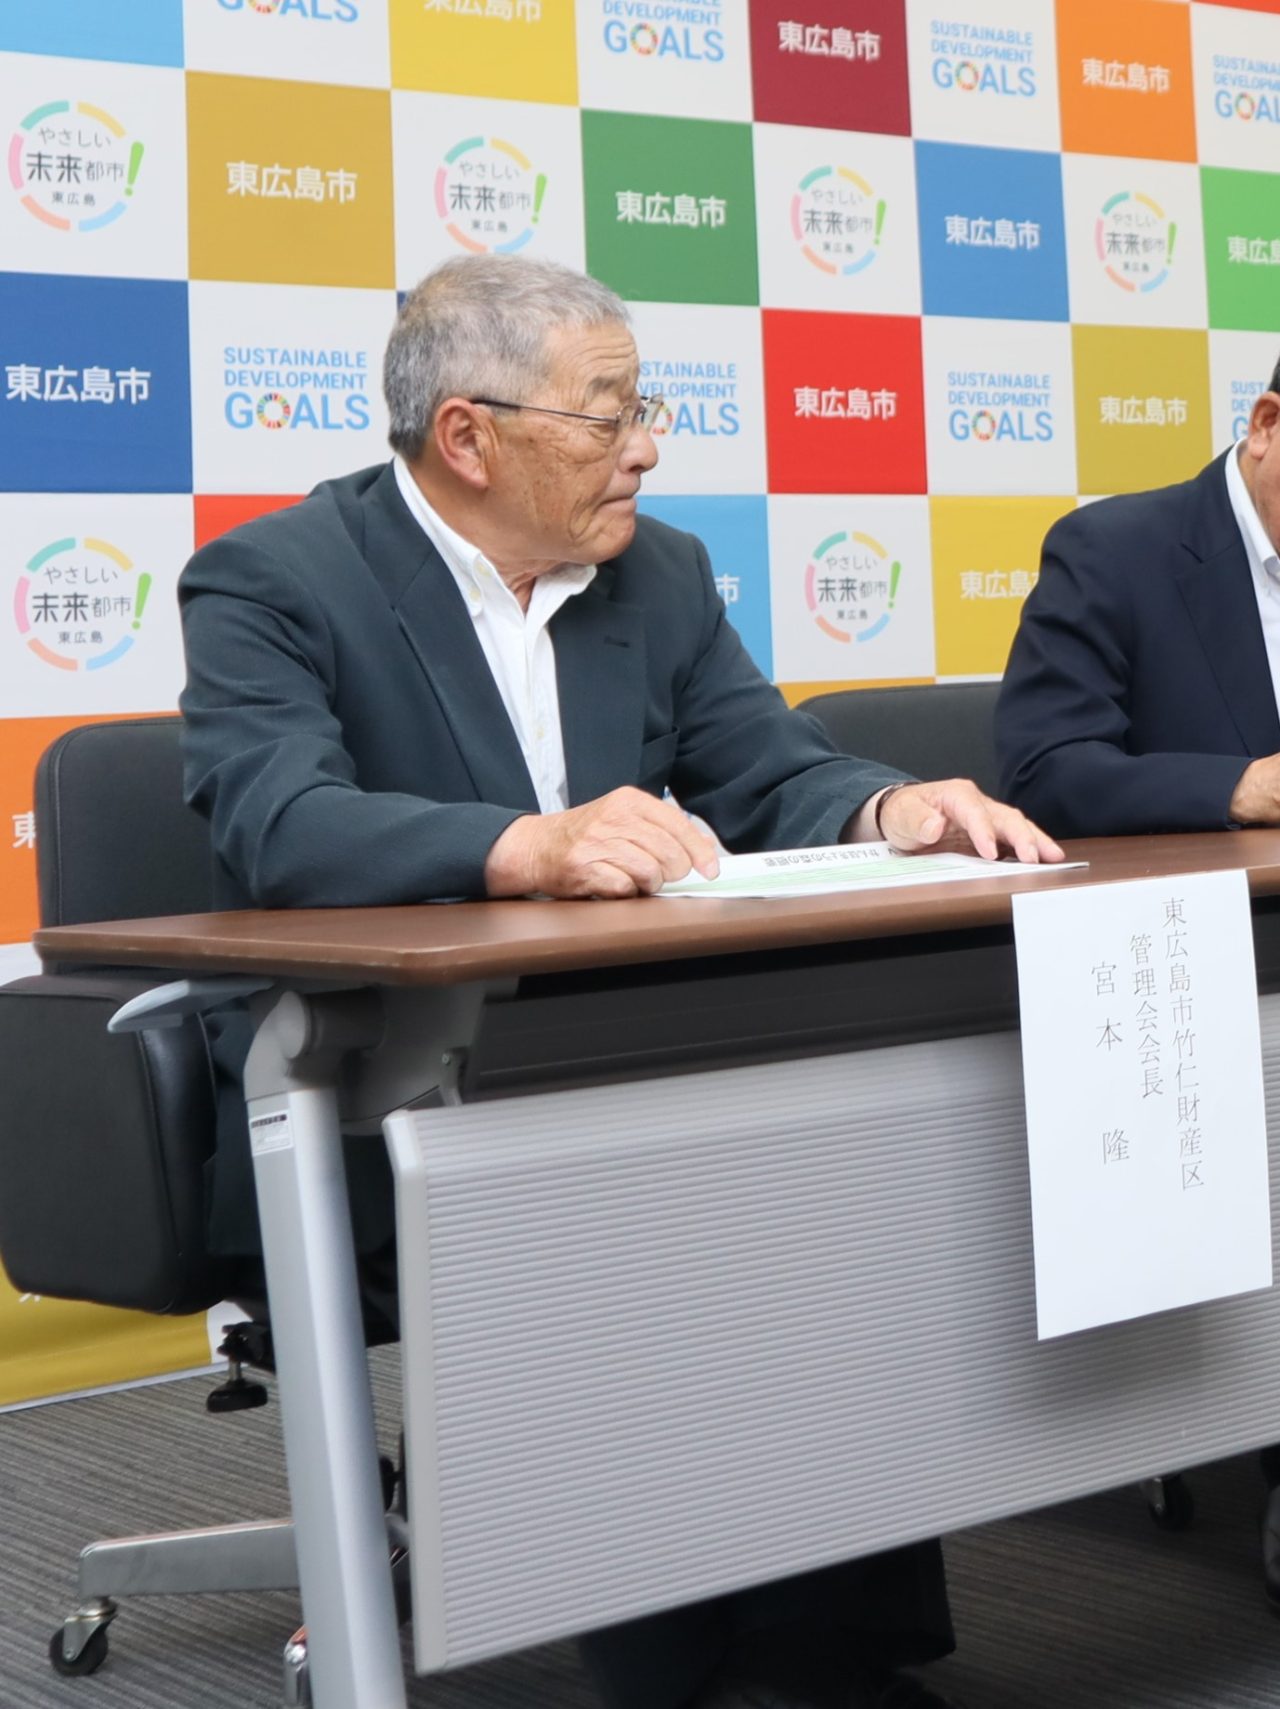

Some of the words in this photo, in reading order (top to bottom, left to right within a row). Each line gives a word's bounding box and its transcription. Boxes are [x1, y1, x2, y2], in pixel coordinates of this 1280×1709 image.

[603, 0, 720, 25] DEVELOPMENT
[604, 20, 724, 62] GOALS
[778, 21, 880, 61] 東広島市
[931, 20, 1033, 46] SUSTAINABLE
[931, 38, 1033, 62] DEVELOPMENT
[932, 58, 1036, 96] GOALS
[1082, 58, 1169, 92] 東広島市
[38, 127, 111, 148] やさしい
[227, 161, 357, 203] 東広島市
[459, 161, 520, 179] やさしい
[51, 191, 95, 206] 東広島
[616, 190, 726, 228] 東広島市
[945, 215, 1040, 250] 東広島市
[224, 347, 367, 368] SUSTAINABLE
[640, 361, 736, 378] STAINABLE
[5, 364, 151, 404] 東広島市
[224, 369, 367, 390] DEVELOPMENT
[639, 381, 736, 398] VELOPMENT
[947, 371, 1050, 389] SUSTAINABLE
[225, 391, 370, 431] GOALS
[794, 386, 897, 421] 東広島市
[948, 390, 1050, 407] DEVELOPMENT
[949, 409, 1053, 442] GOALS
[1100, 397, 1188, 429] 東広島市
[44, 566, 118, 584] やさしい
[826, 556, 878, 570] やさしい
[58, 631, 103, 644] 東広島
[1129, 933, 1164, 1099] 管理会会長
[1161, 896, 1205, 1191] 東広島市竹仁財産区
